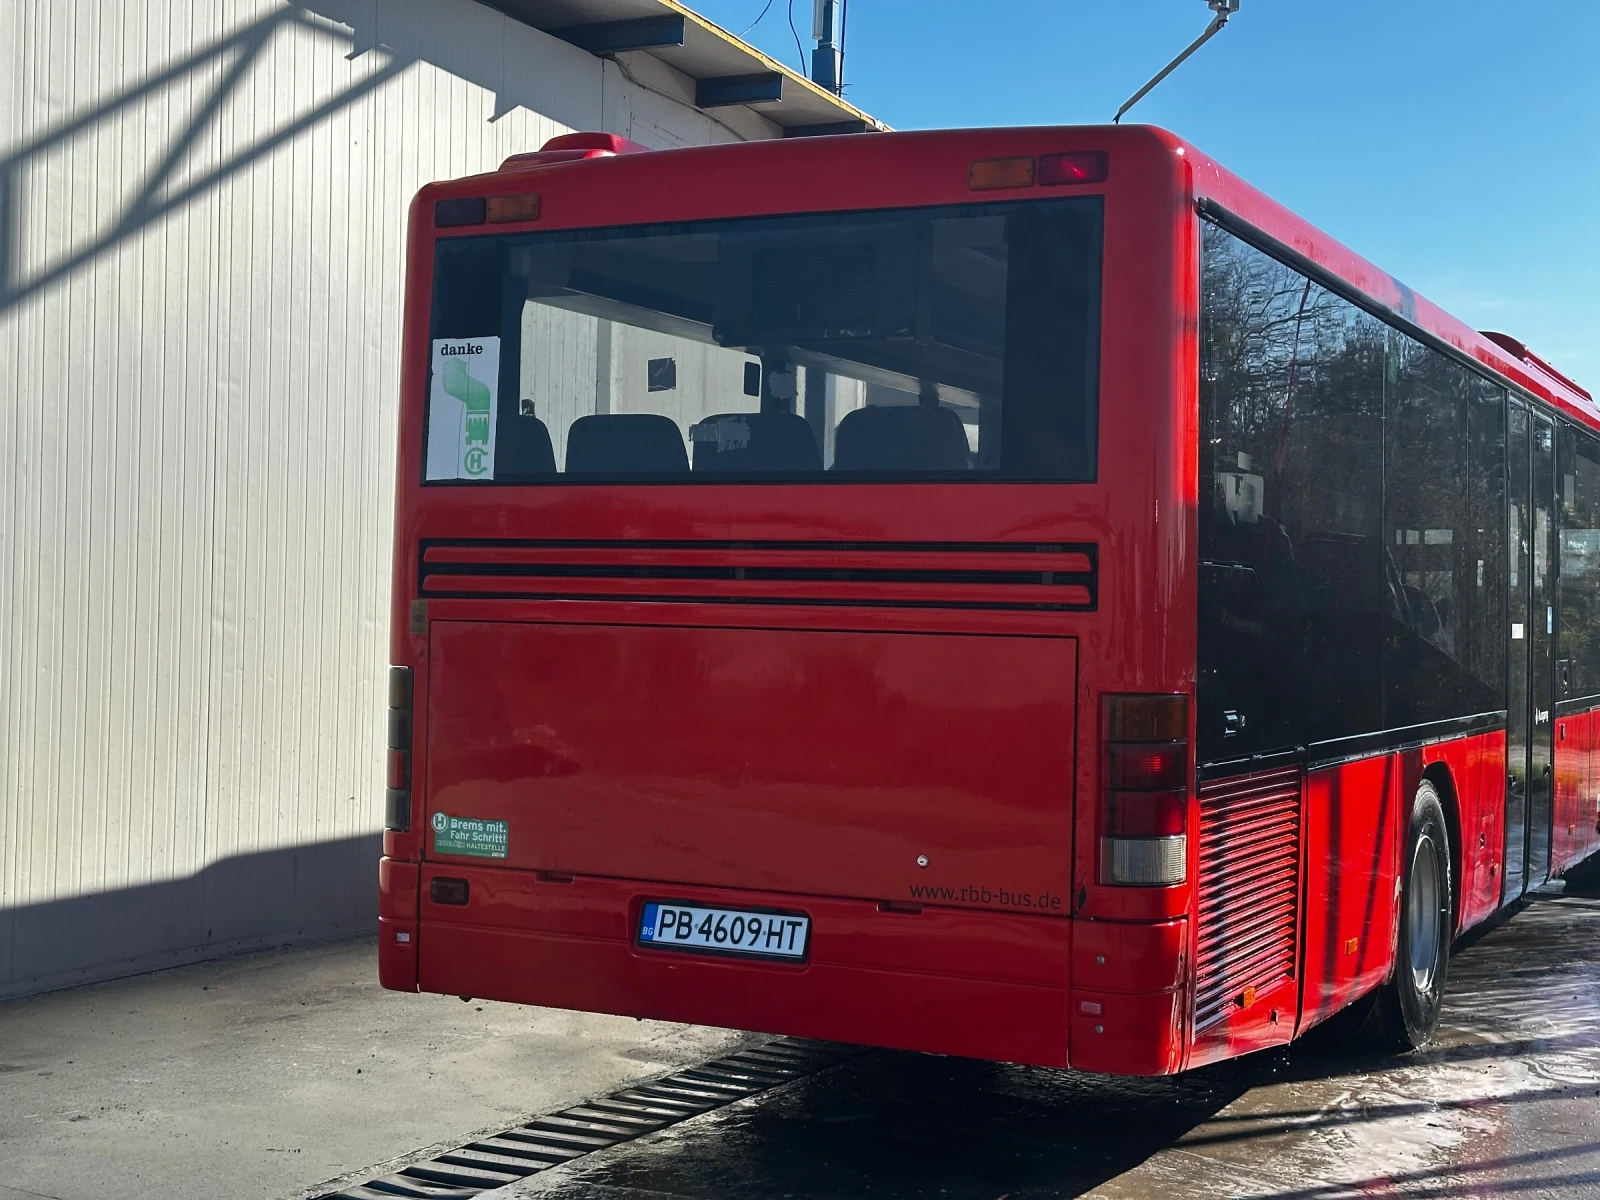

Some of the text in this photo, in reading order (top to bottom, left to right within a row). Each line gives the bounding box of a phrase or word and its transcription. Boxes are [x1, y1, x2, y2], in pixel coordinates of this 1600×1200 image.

[440, 343, 483, 356] danke
[450, 818, 507, 833] Brems mit.
[450, 830, 470, 840] Fahr
[472, 831, 506, 844] Schritt!
[466, 842, 506, 852] HALTESTELLE
[909, 884, 1062, 910] www.rbb-bus.de
[642, 926, 654, 936] BG
